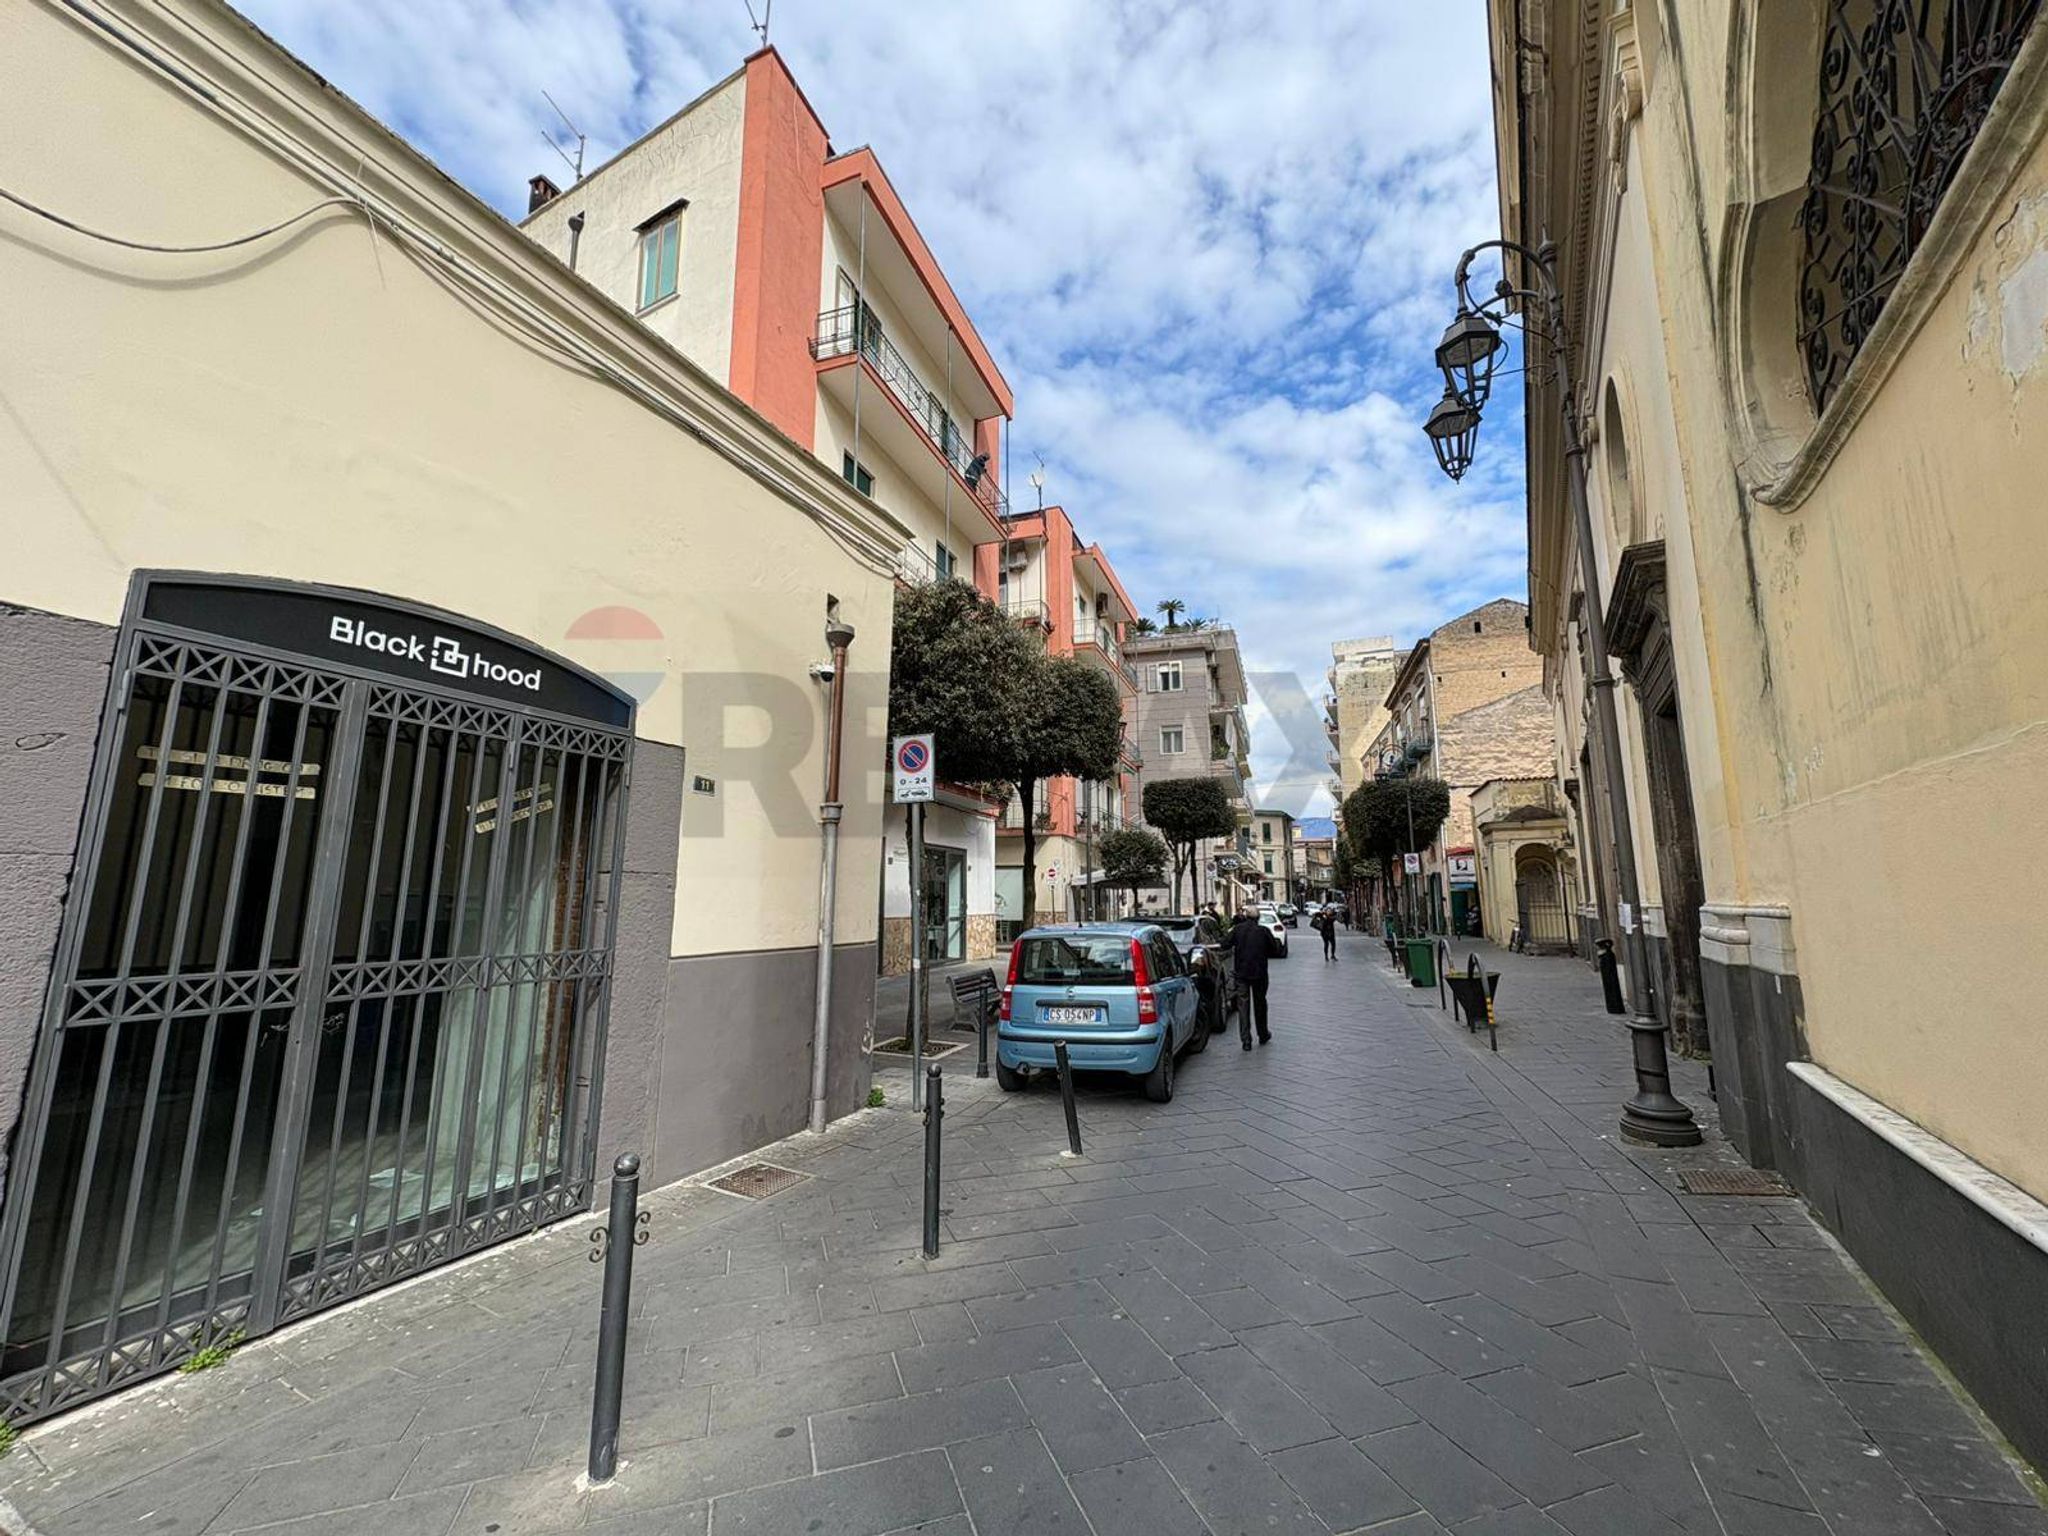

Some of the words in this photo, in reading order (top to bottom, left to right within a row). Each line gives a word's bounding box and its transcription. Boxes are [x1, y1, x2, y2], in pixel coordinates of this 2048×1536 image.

[330, 615, 425, 662] Black
[472, 652, 542, 690] hood
[700, 779, 710, 790] 11
[914, 776, 927, 785] 24
